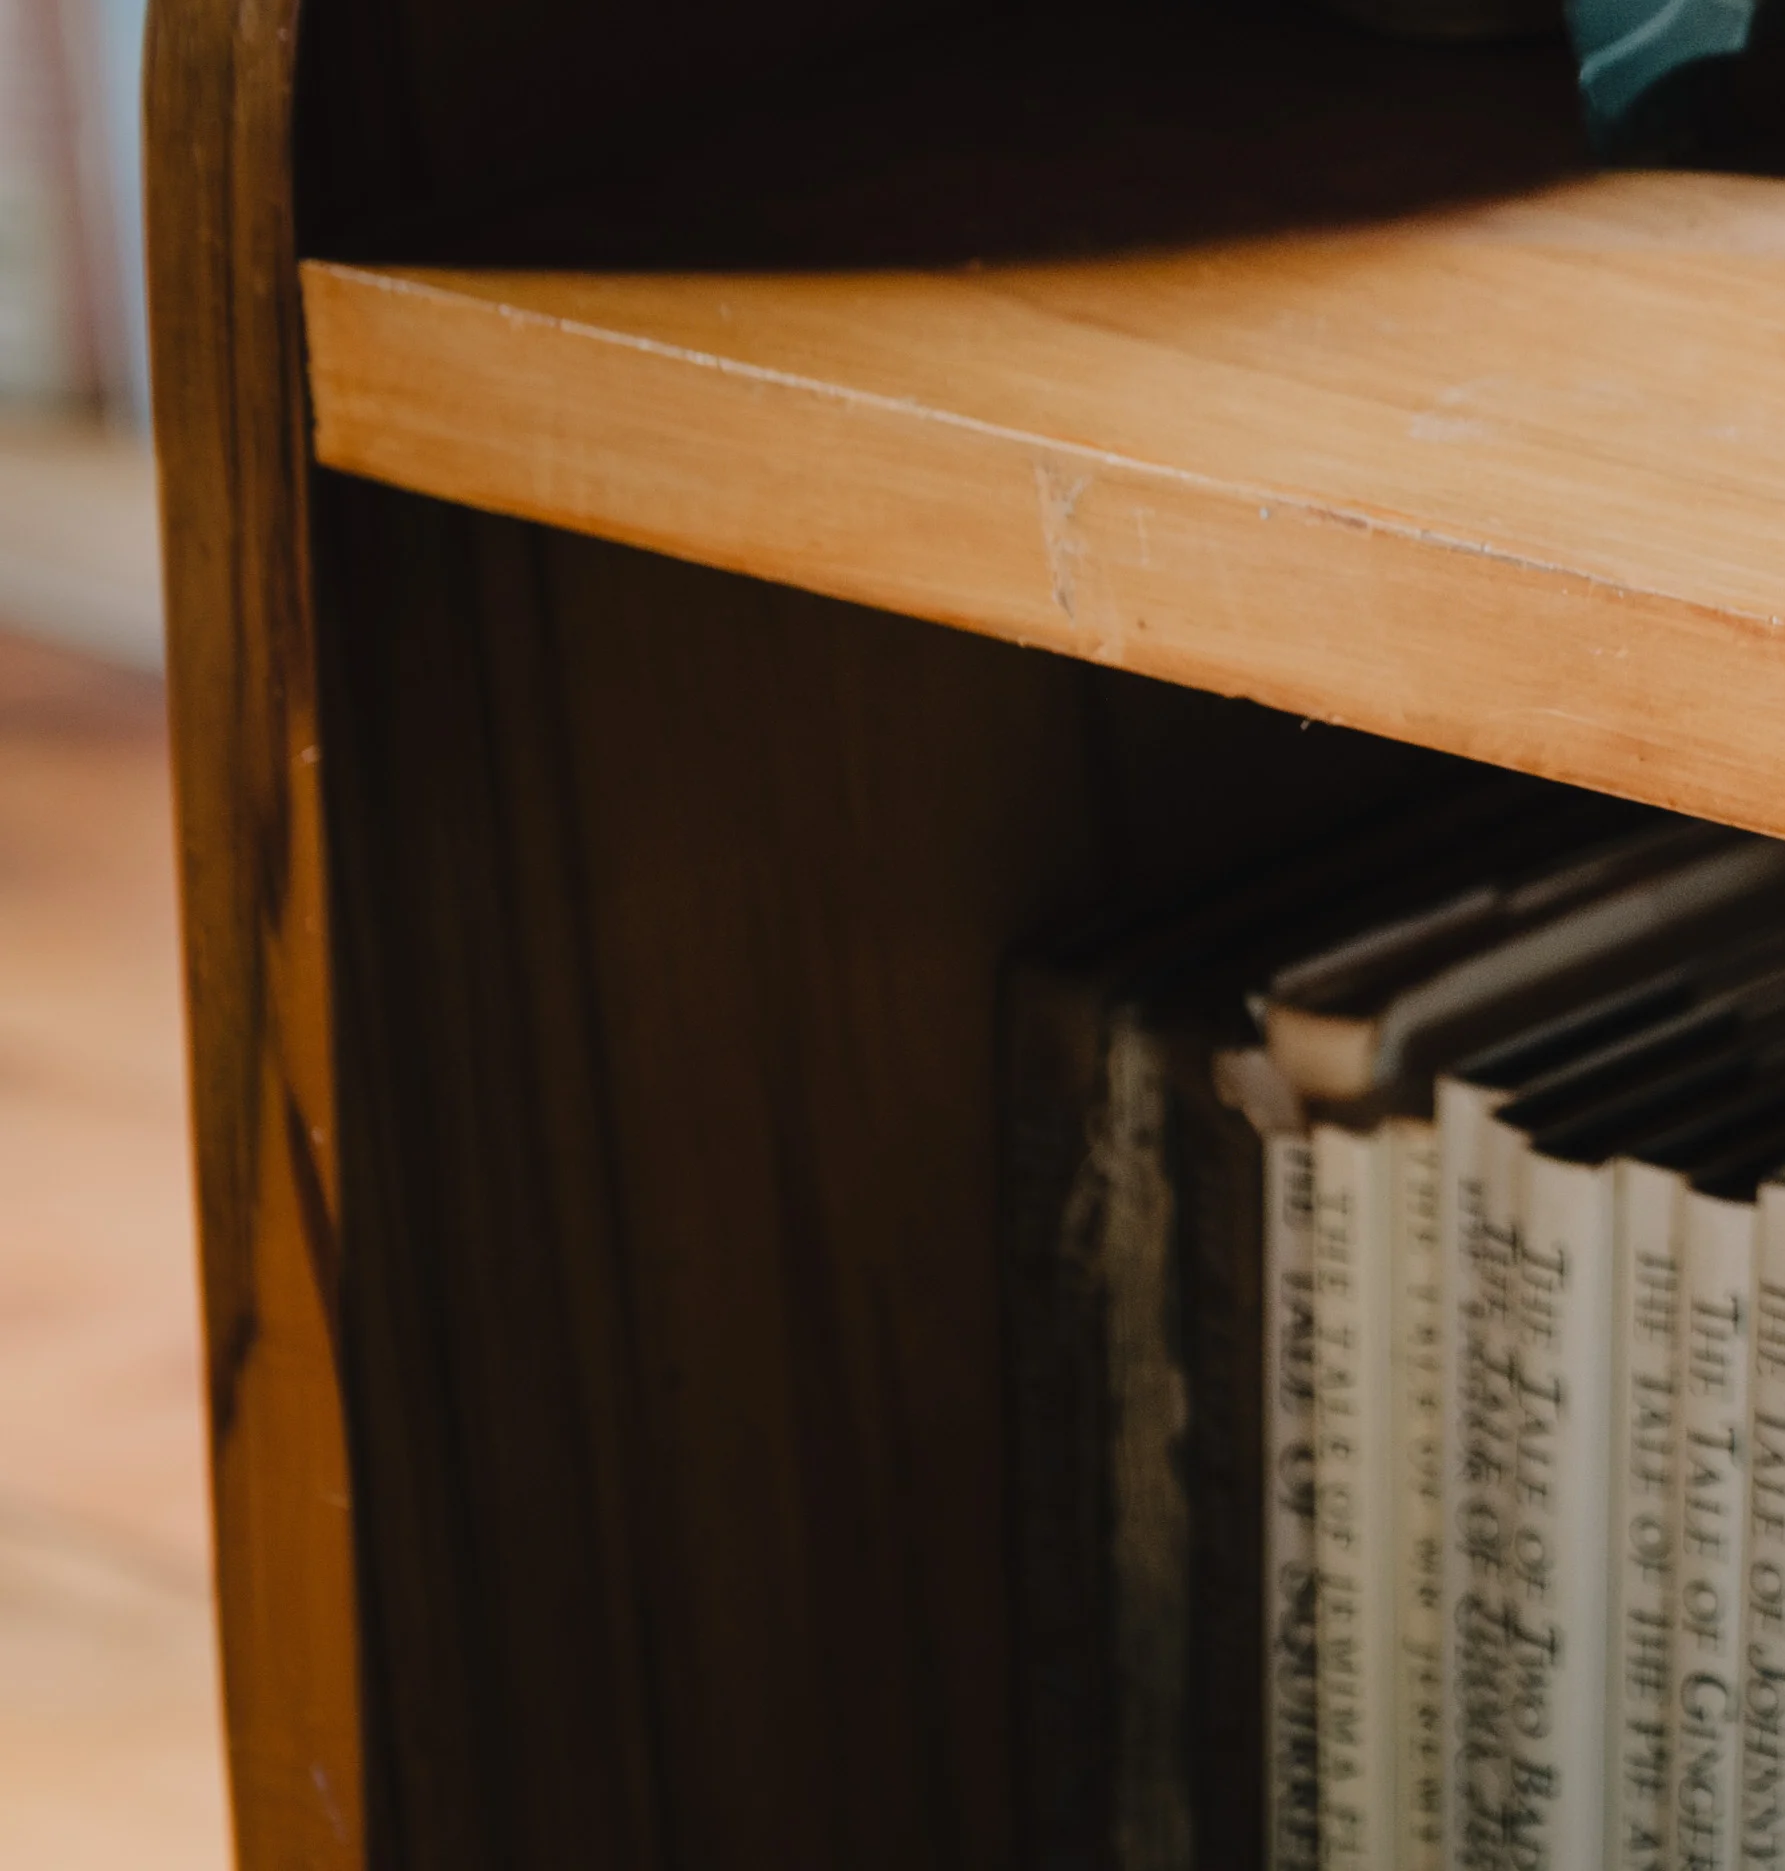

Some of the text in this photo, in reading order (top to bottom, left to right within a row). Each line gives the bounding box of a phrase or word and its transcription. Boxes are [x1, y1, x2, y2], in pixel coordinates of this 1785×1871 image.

[1519, 1240, 1569, 1350] THE
[1634, 1248, 1684, 1344] THE
[1689, 1290, 1751, 1404] THE
[1514, 1370, 1569, 1510] TALE
[1631, 1368, 1682, 1498] TALE
[1682, 1423, 1746, 1565] TALE
[1512, 1524, 1554, 1598] OF
[1628, 1512, 1678, 1588] OF
[1625, 1604, 1676, 1704] THE
[1680, 1576, 1730, 1660] OF
